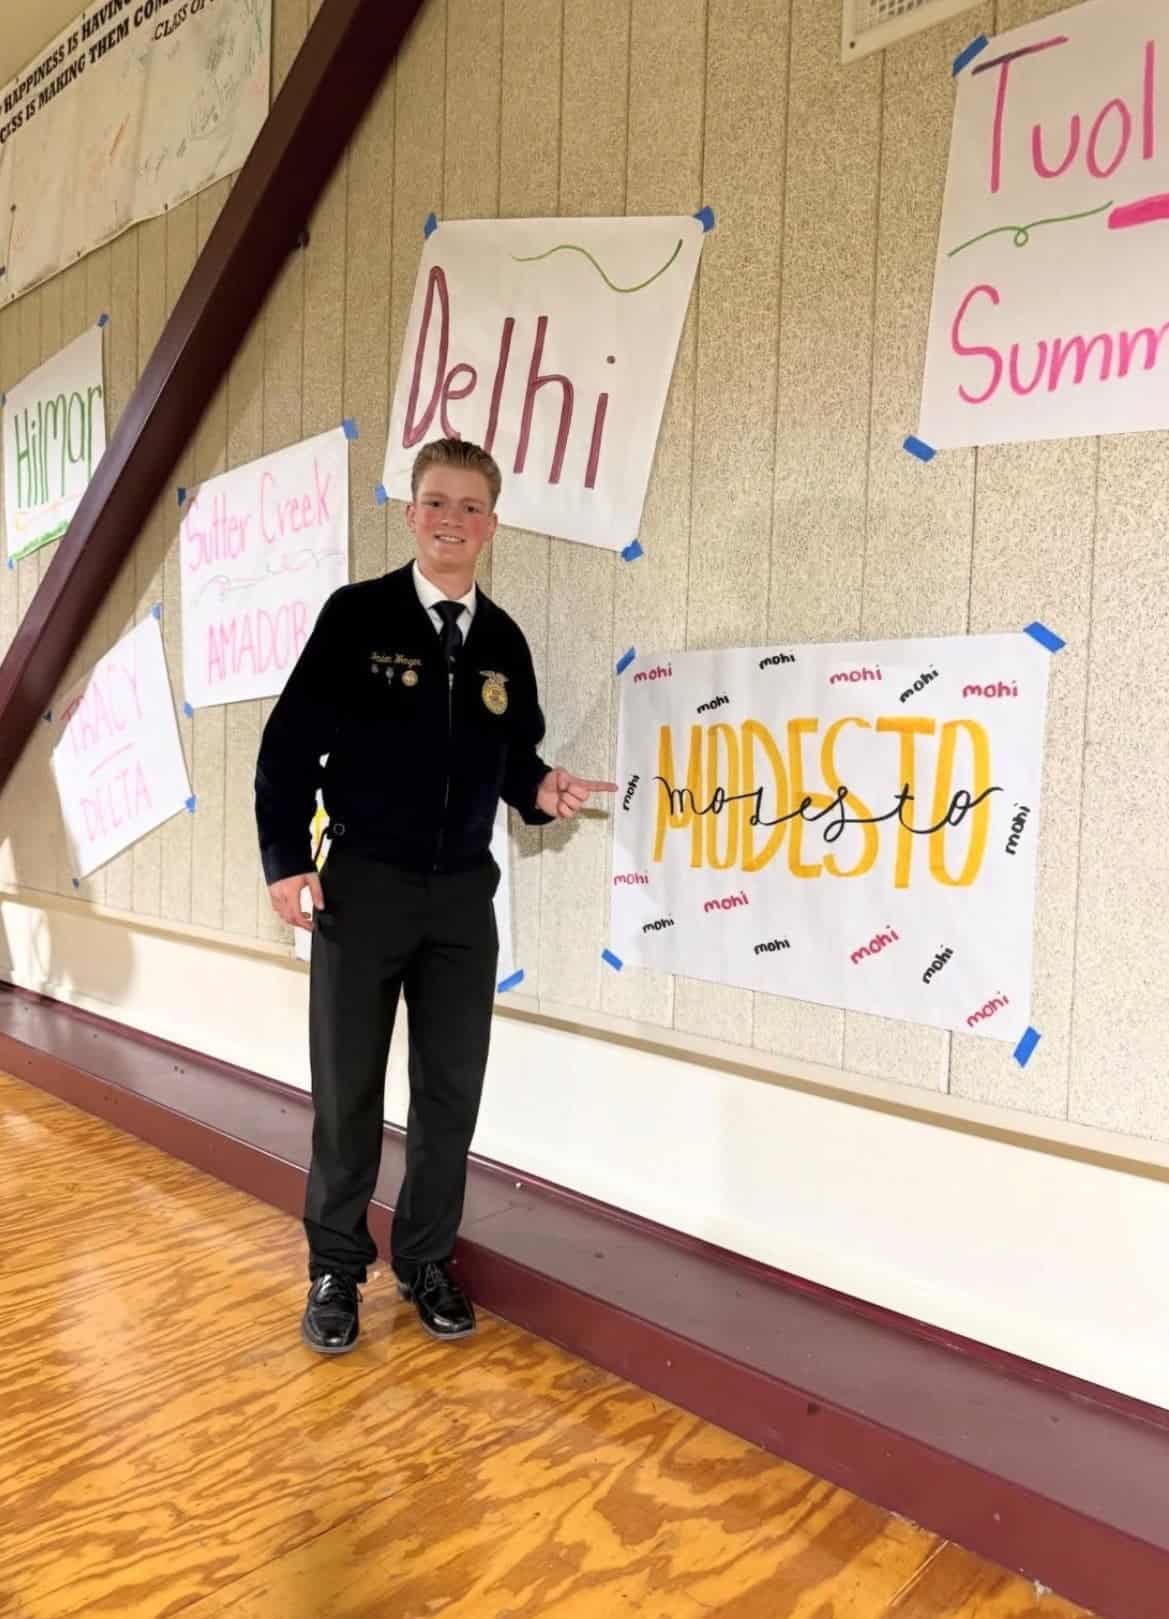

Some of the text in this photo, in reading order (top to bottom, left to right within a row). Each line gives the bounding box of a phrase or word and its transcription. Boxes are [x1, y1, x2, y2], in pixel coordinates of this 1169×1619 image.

[152, 4, 188, 41] CLASS
[4, 0, 131, 114] HAPPINESS IS HAVIN
[25, 99, 36, 121] IS
[38, 54, 86, 110] MAKING
[88, 16, 129, 64] THEM
[971, 35, 1156, 194] Tuol
[402, 265, 617, 489] Delhi
[14, 383, 104, 510] Hilmar
[185, 455, 332, 572] Sutter Creek
[633, 663, 673, 684] mohi
[758, 649, 797, 671] mohi
[829, 663, 883, 687] mohi
[696, 693, 731, 715] mohi
[899, 662, 940, 704] mohi
[961, 679, 1019, 699] mohi
[80, 758, 153, 845] DELTA
[622, 773, 641, 812] mohi
[653, 715, 992, 889] MODESTO
[653, 775, 1004, 843] modesto
[1004, 801, 1032, 856] mohi
[612, 871, 650, 888] mohi
[703, 890, 750, 914] mohi
[641, 917, 676, 935] mohi
[753, 937, 791, 956] mohi
[849, 924, 900, 966] mohi
[922, 943, 955, 985] mohi
[966, 990, 1010, 1028] mohi
